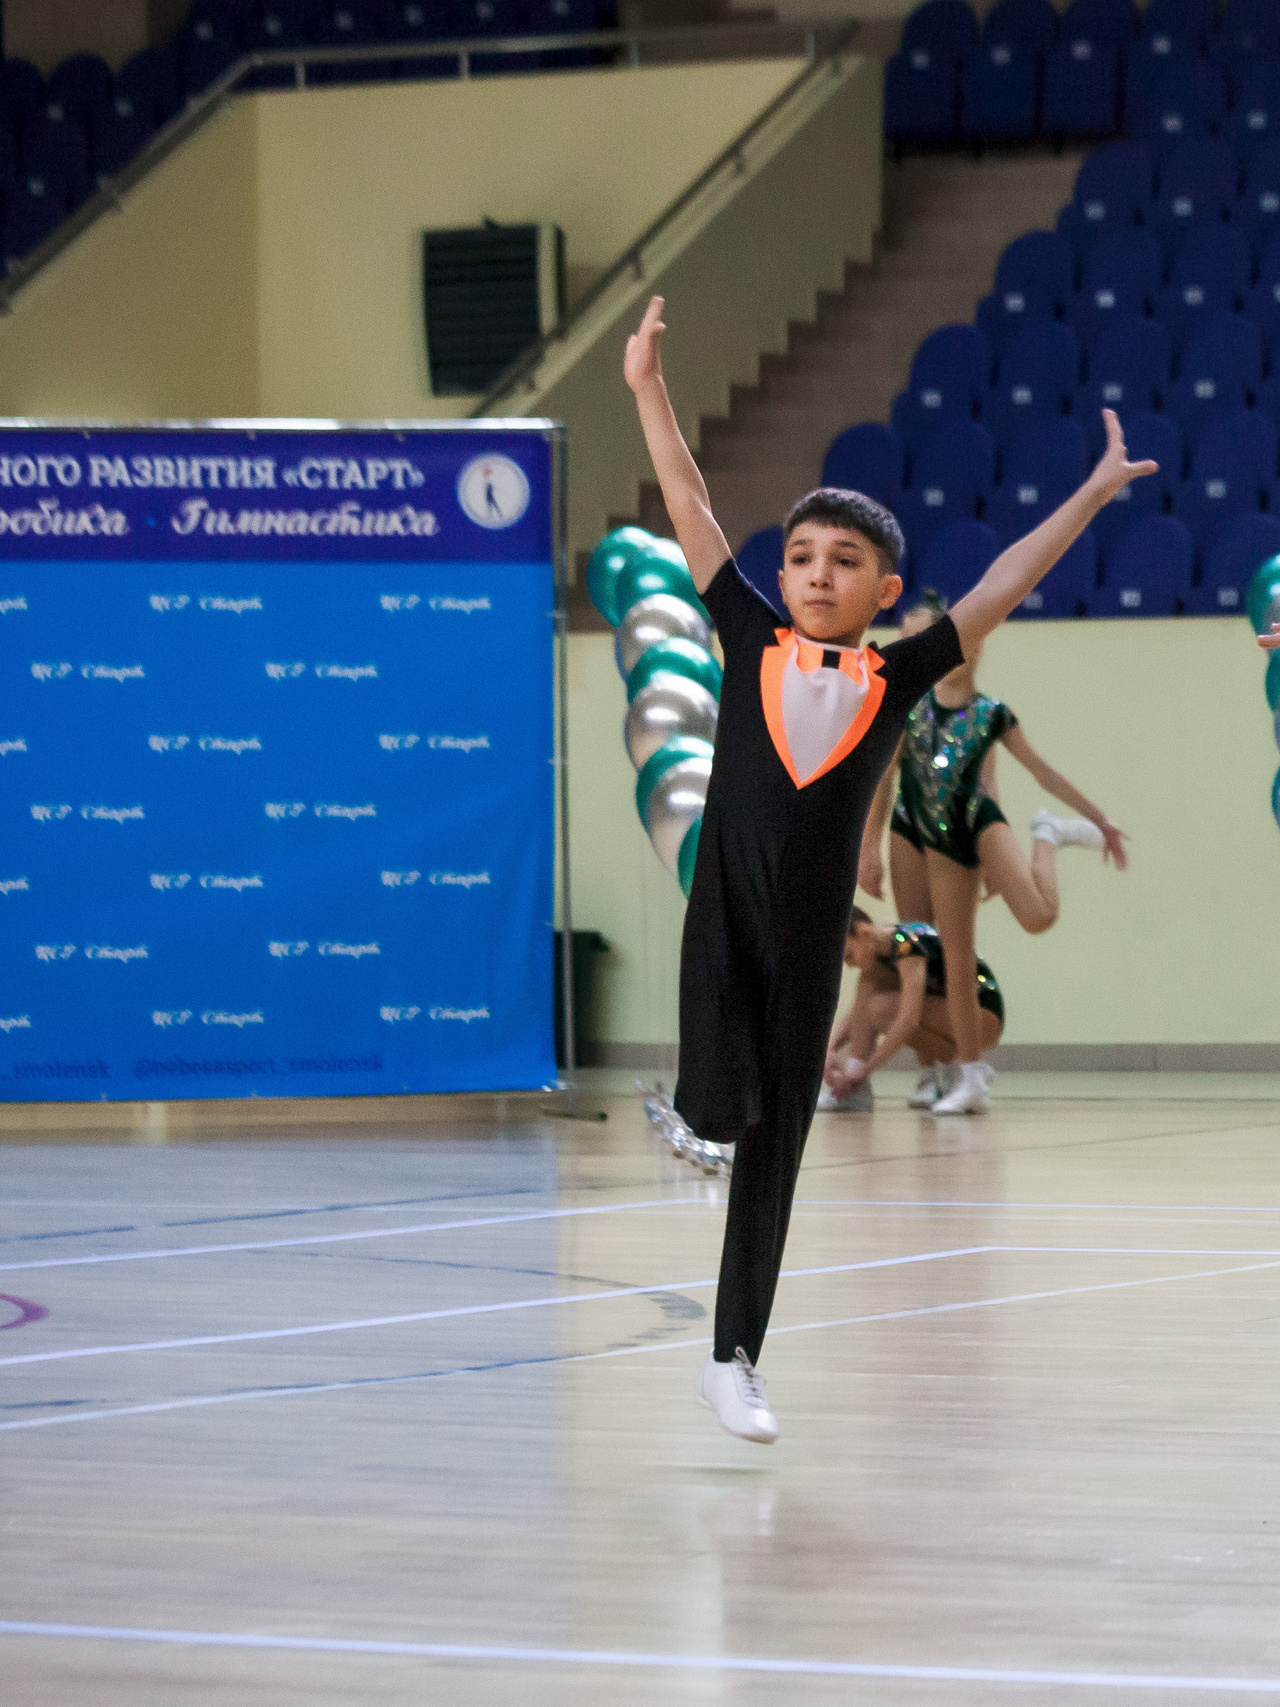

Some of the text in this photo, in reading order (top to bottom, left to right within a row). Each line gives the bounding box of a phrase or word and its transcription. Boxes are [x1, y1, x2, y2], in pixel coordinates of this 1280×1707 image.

[88, 456, 277, 489] РАЗВИТИЯ
[282, 458, 426, 490] «СТАРТ»
[171, 498, 438, 536] Гимнастика
